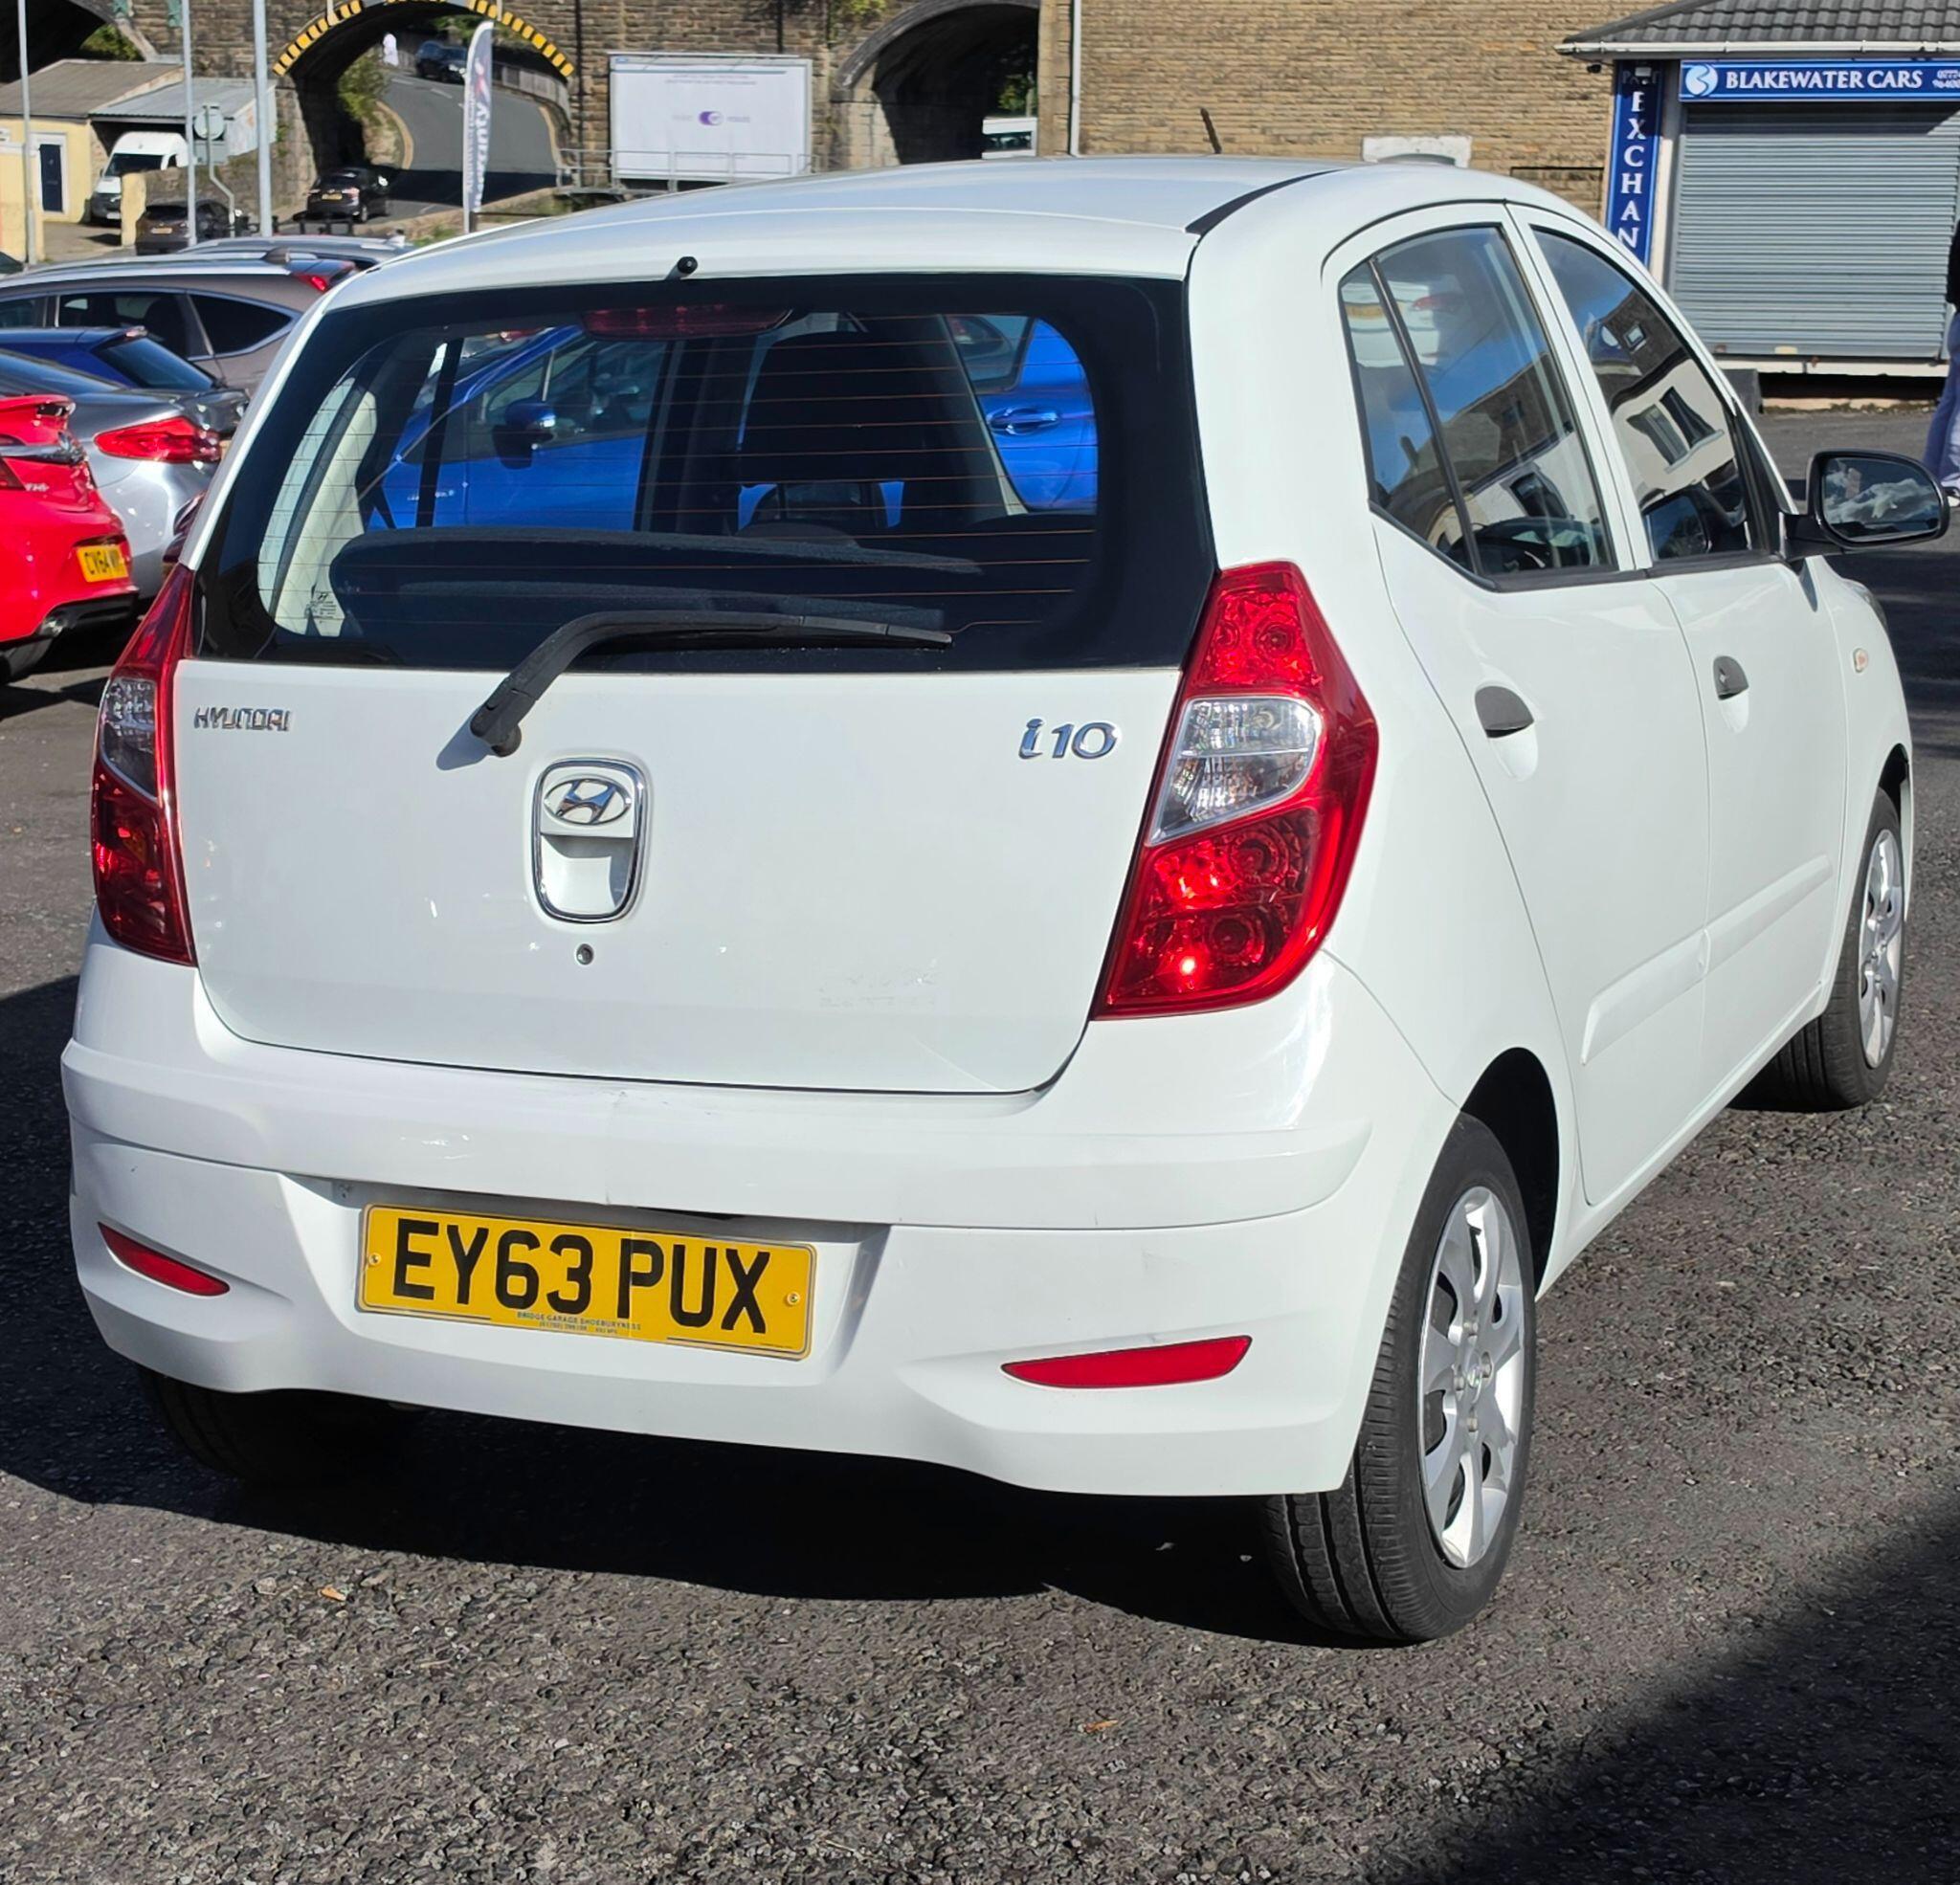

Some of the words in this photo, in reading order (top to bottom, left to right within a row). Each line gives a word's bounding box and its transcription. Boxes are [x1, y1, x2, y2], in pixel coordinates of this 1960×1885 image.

[1726, 70, 1864, 89] BLAKEWATER
[1867, 70, 1924, 89] CARS
[193, 706, 290, 731] HYUNDAI
[1017, 719, 1118, 760] i10
[392, 1217, 594, 1316] EY63
[615, 1237, 771, 1335] PUX
[517, 1311, 545, 1321] BRIDGE
[546, 1314, 578, 1324] GARAGE
[580, 1317, 642, 1330] SHOEBURYNESS
